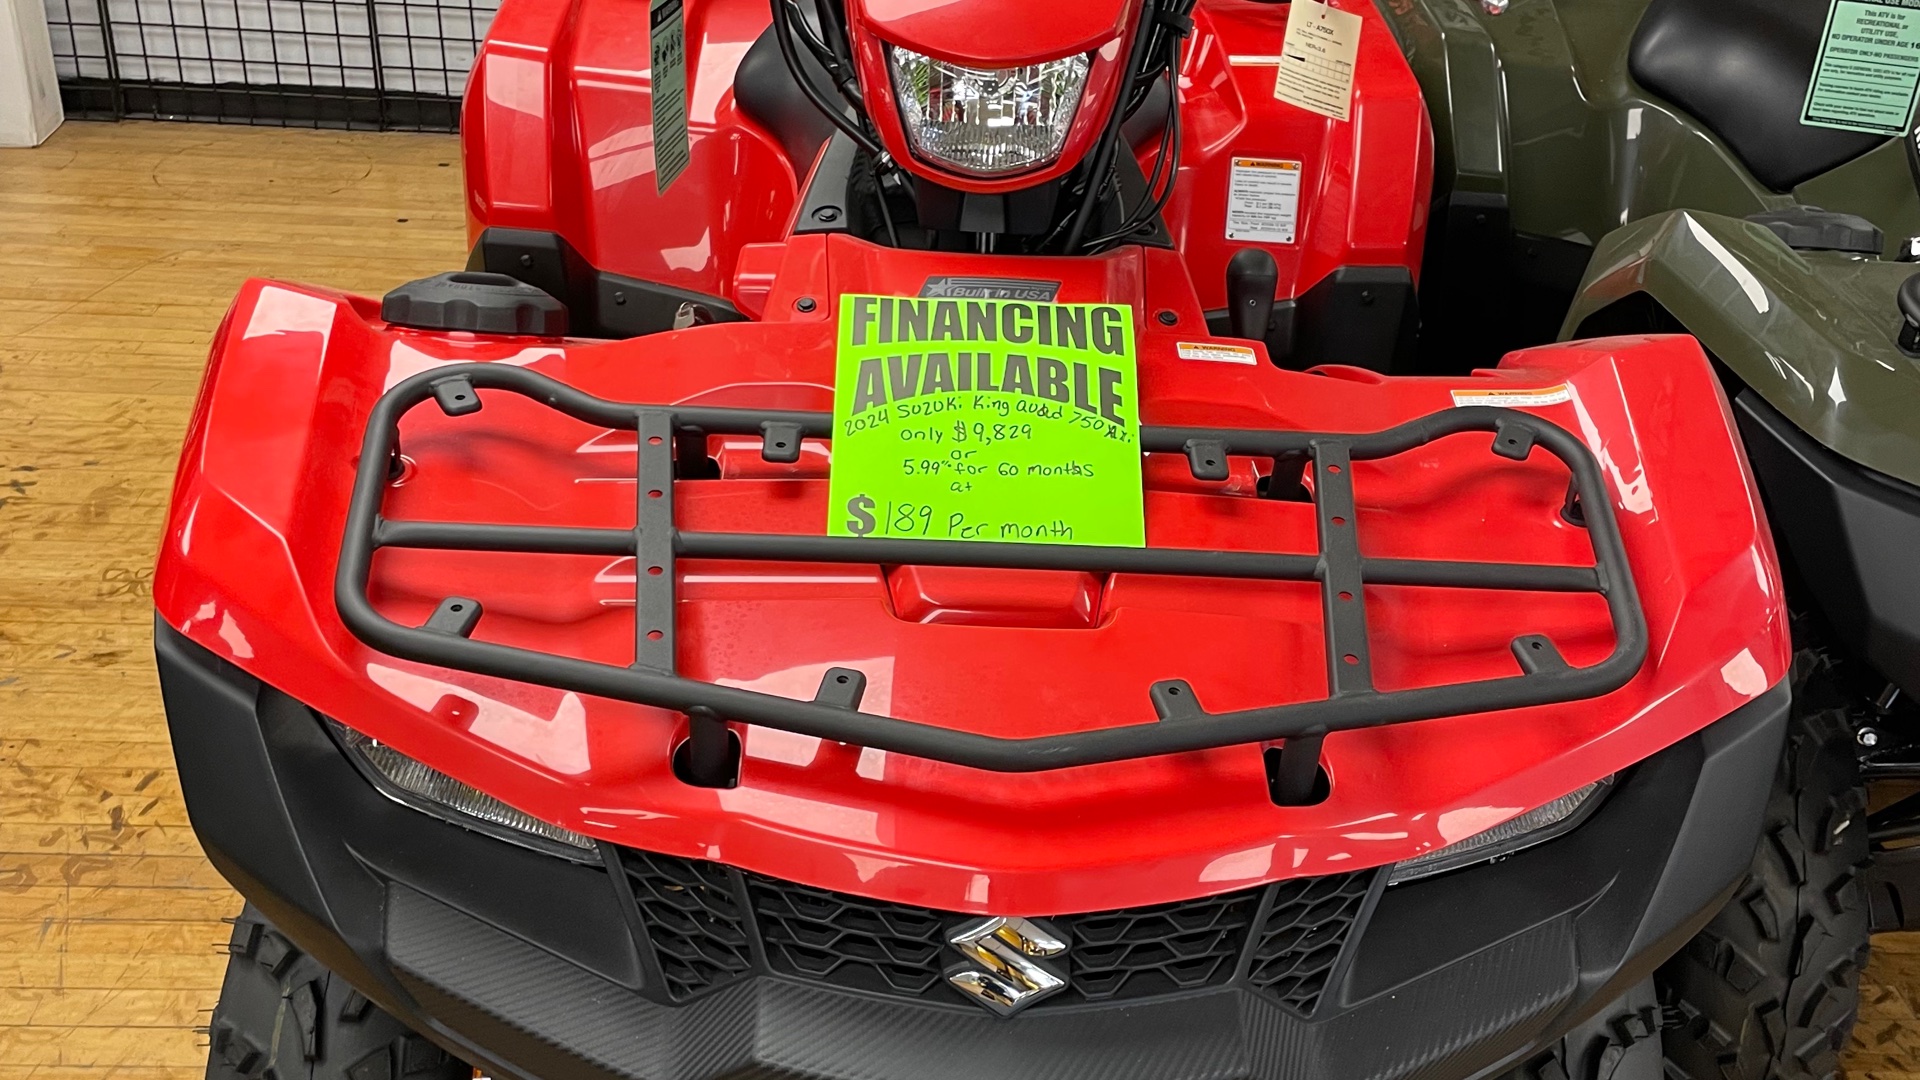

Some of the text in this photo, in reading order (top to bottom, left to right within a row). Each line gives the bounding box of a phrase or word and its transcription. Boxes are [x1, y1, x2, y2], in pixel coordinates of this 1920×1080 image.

[1856, 18, 1901, 29] RECREATIONAL
[1861, 28, 1884, 36] UTILITY
[1841, 34, 1873, 43] OPERATOR
[1874, 38, 1896, 46] UNDER
[1015, 290, 1051, 300] USA
[851, 296, 1125, 356] FINANCING
[851, 352, 1125, 427] AVAILABLE
[844, 409, 889, 437] 2024
[973, 395, 1010, 417] King
[951, 420, 1032, 446] $9,829
[950, 450, 977, 460] or
[954, 462, 989, 475] for
[998, 462, 1019, 476] 60
[950, 481, 973, 493] at
[1000, 520, 1074, 540] month
